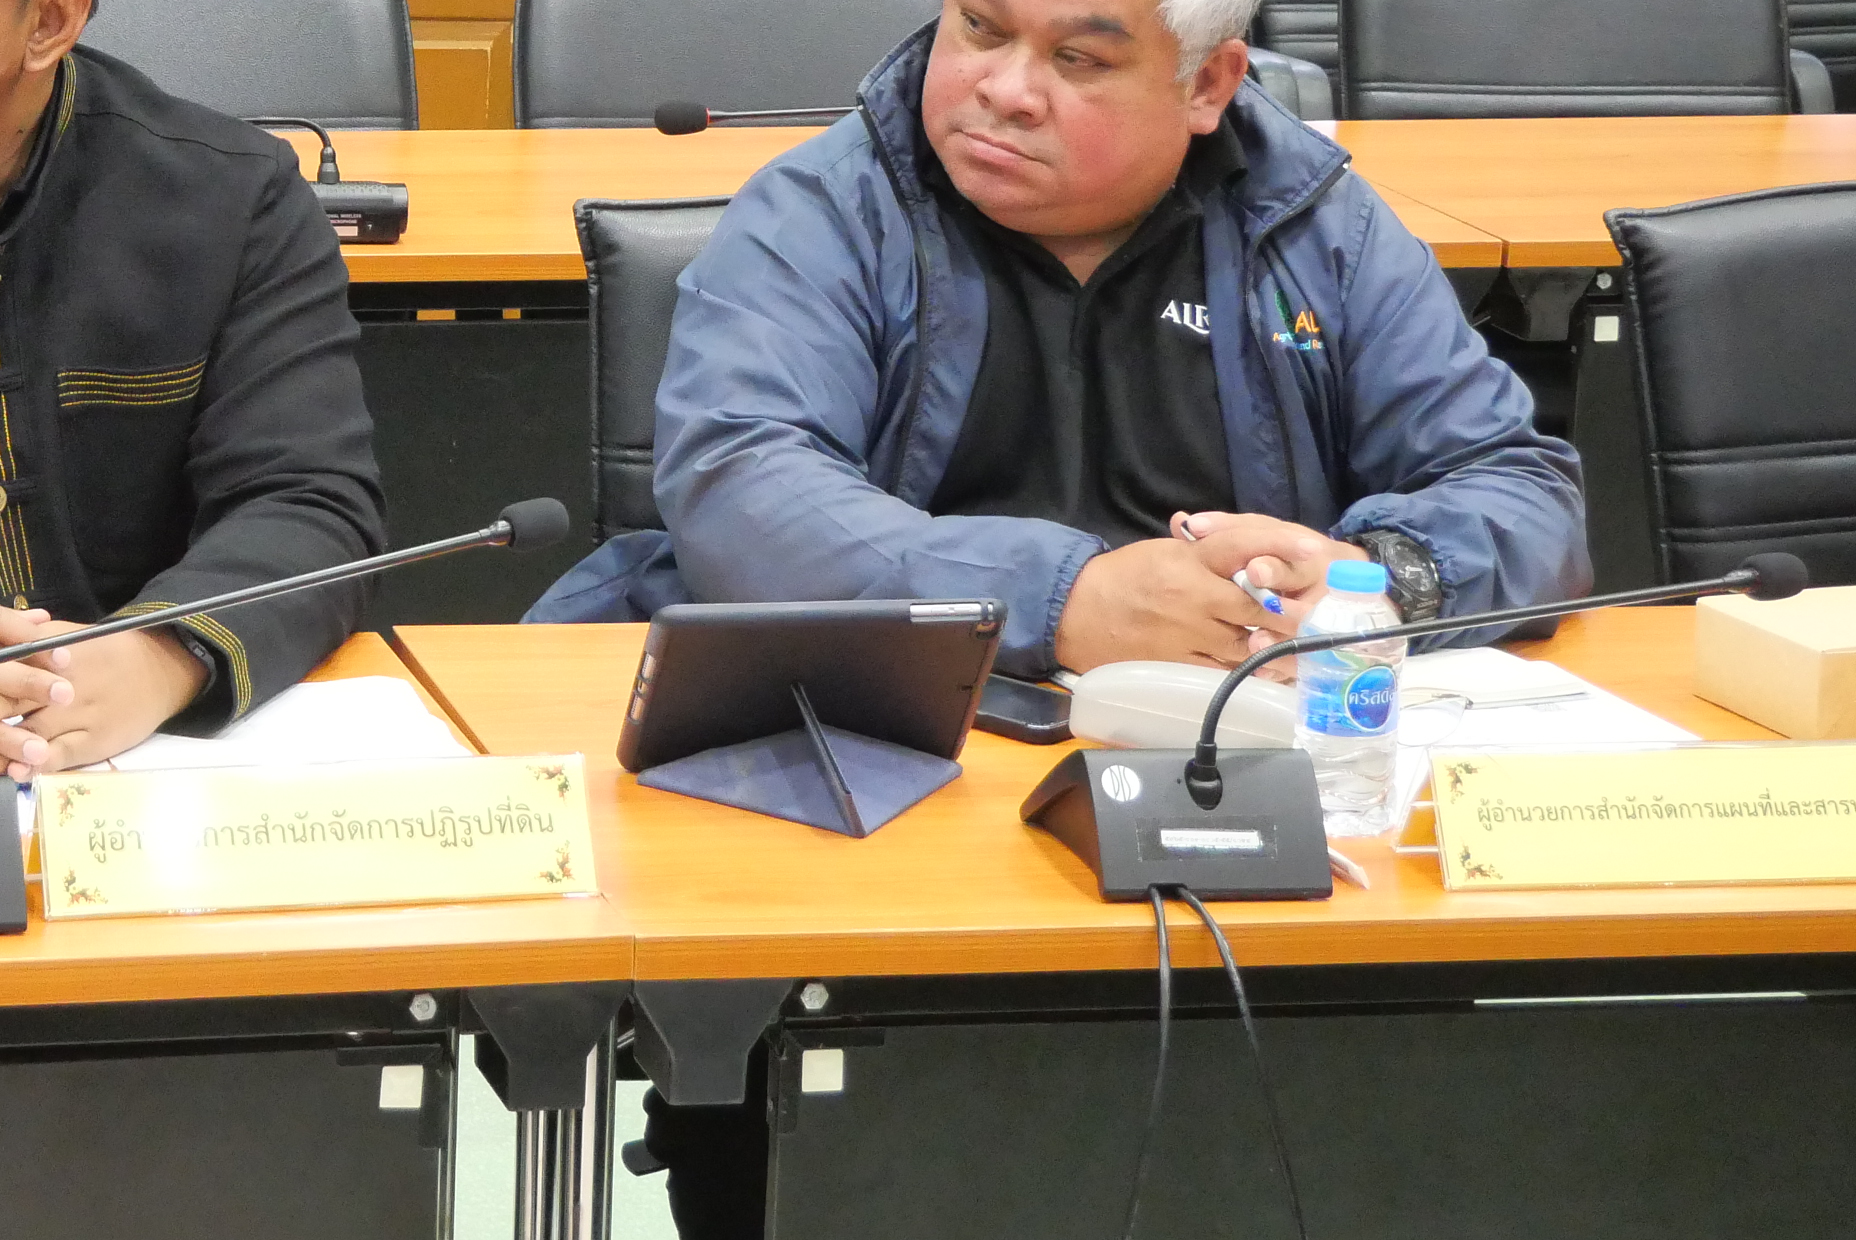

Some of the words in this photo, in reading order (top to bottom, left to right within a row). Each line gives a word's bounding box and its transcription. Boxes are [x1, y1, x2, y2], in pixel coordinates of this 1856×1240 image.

[1160, 299, 1210, 335] ALR
[1294, 310, 1322, 334] AL
[88, 795, 555, 864] ผู้อำการสำนักจัดการปฏิรูปที่ดิน
[1476, 788, 1856, 832] ผู้อำนวยการสำนักจัดการแผนที่และสาร
